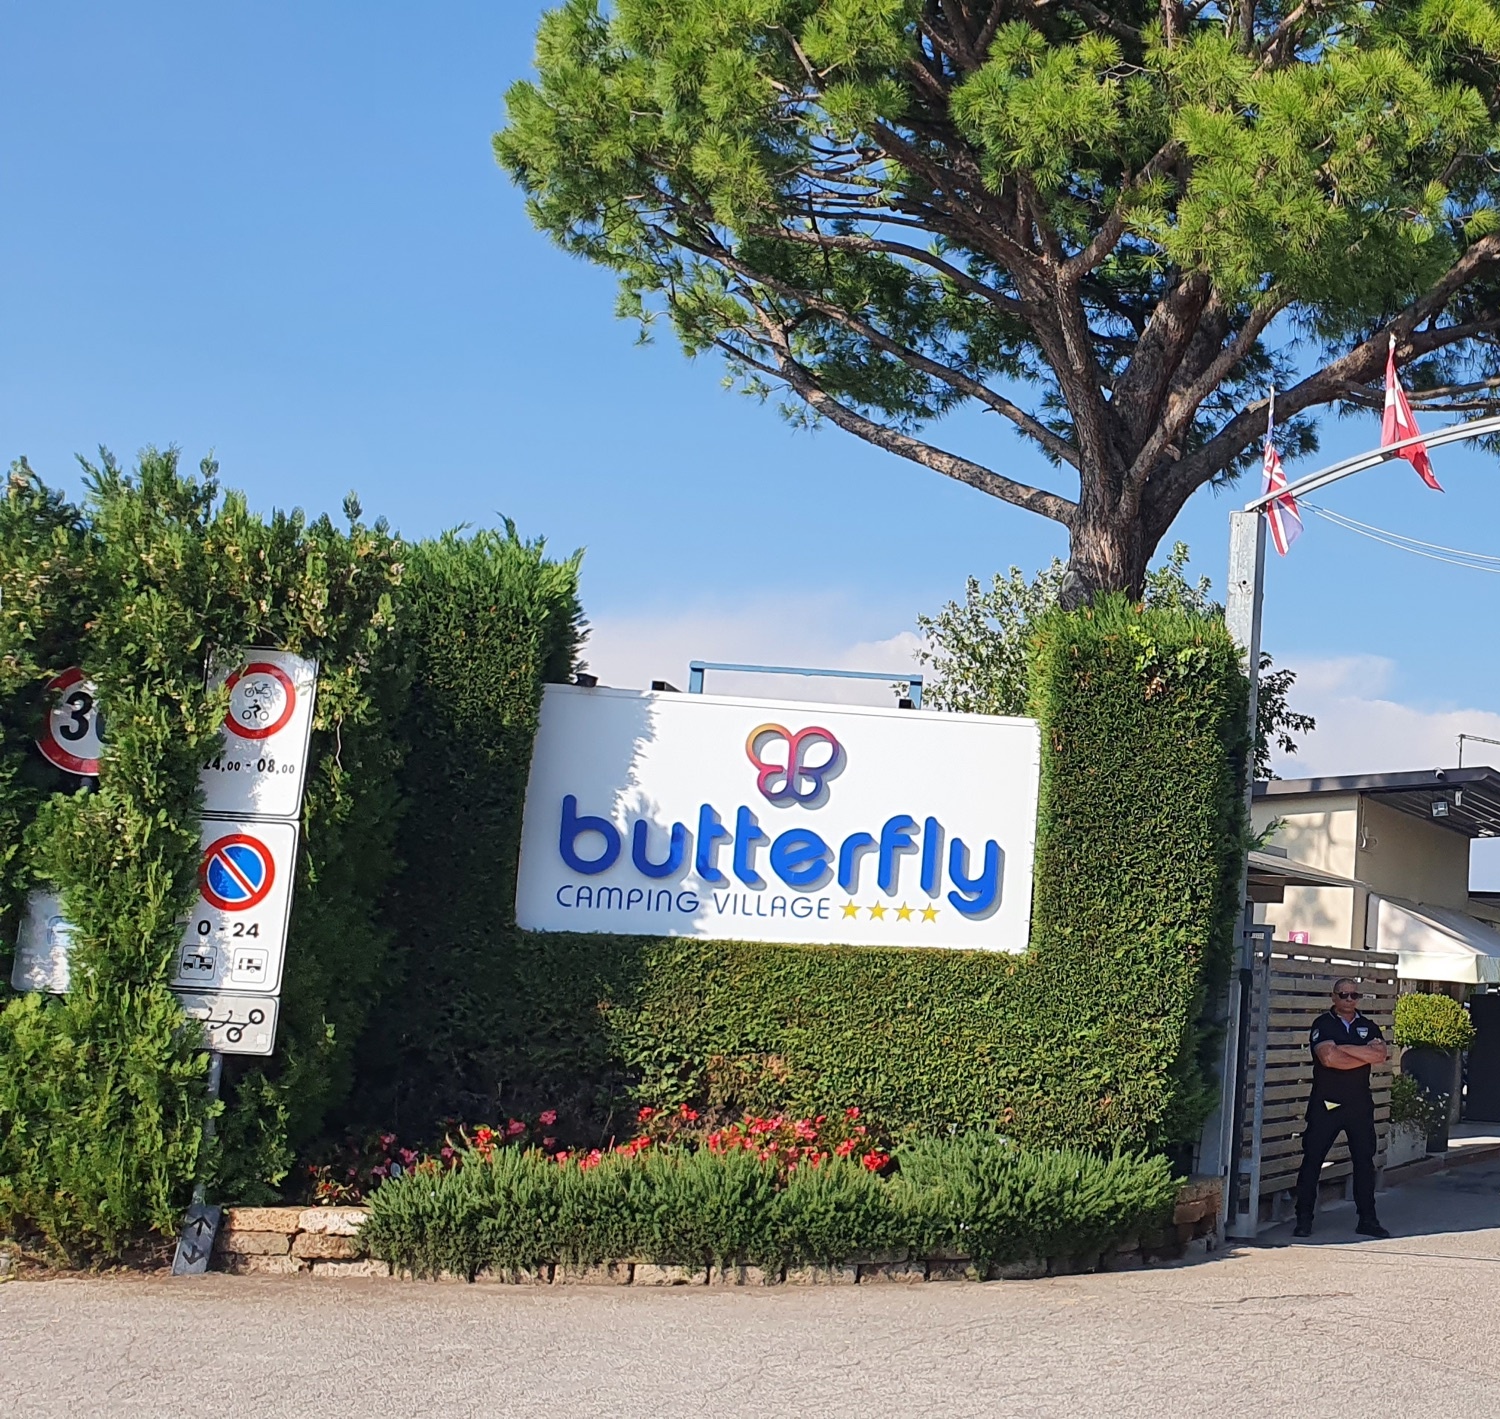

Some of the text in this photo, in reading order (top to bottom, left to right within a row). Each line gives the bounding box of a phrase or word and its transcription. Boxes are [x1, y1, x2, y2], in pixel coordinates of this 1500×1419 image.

[257, 758, 295, 774] 08,00
[559, 794, 1002, 917] butterfly
[556, 884, 830, 920] CAMPING VILLAGE
[197, 920, 211, 936] 0
[232, 922, 260, 938] 24
